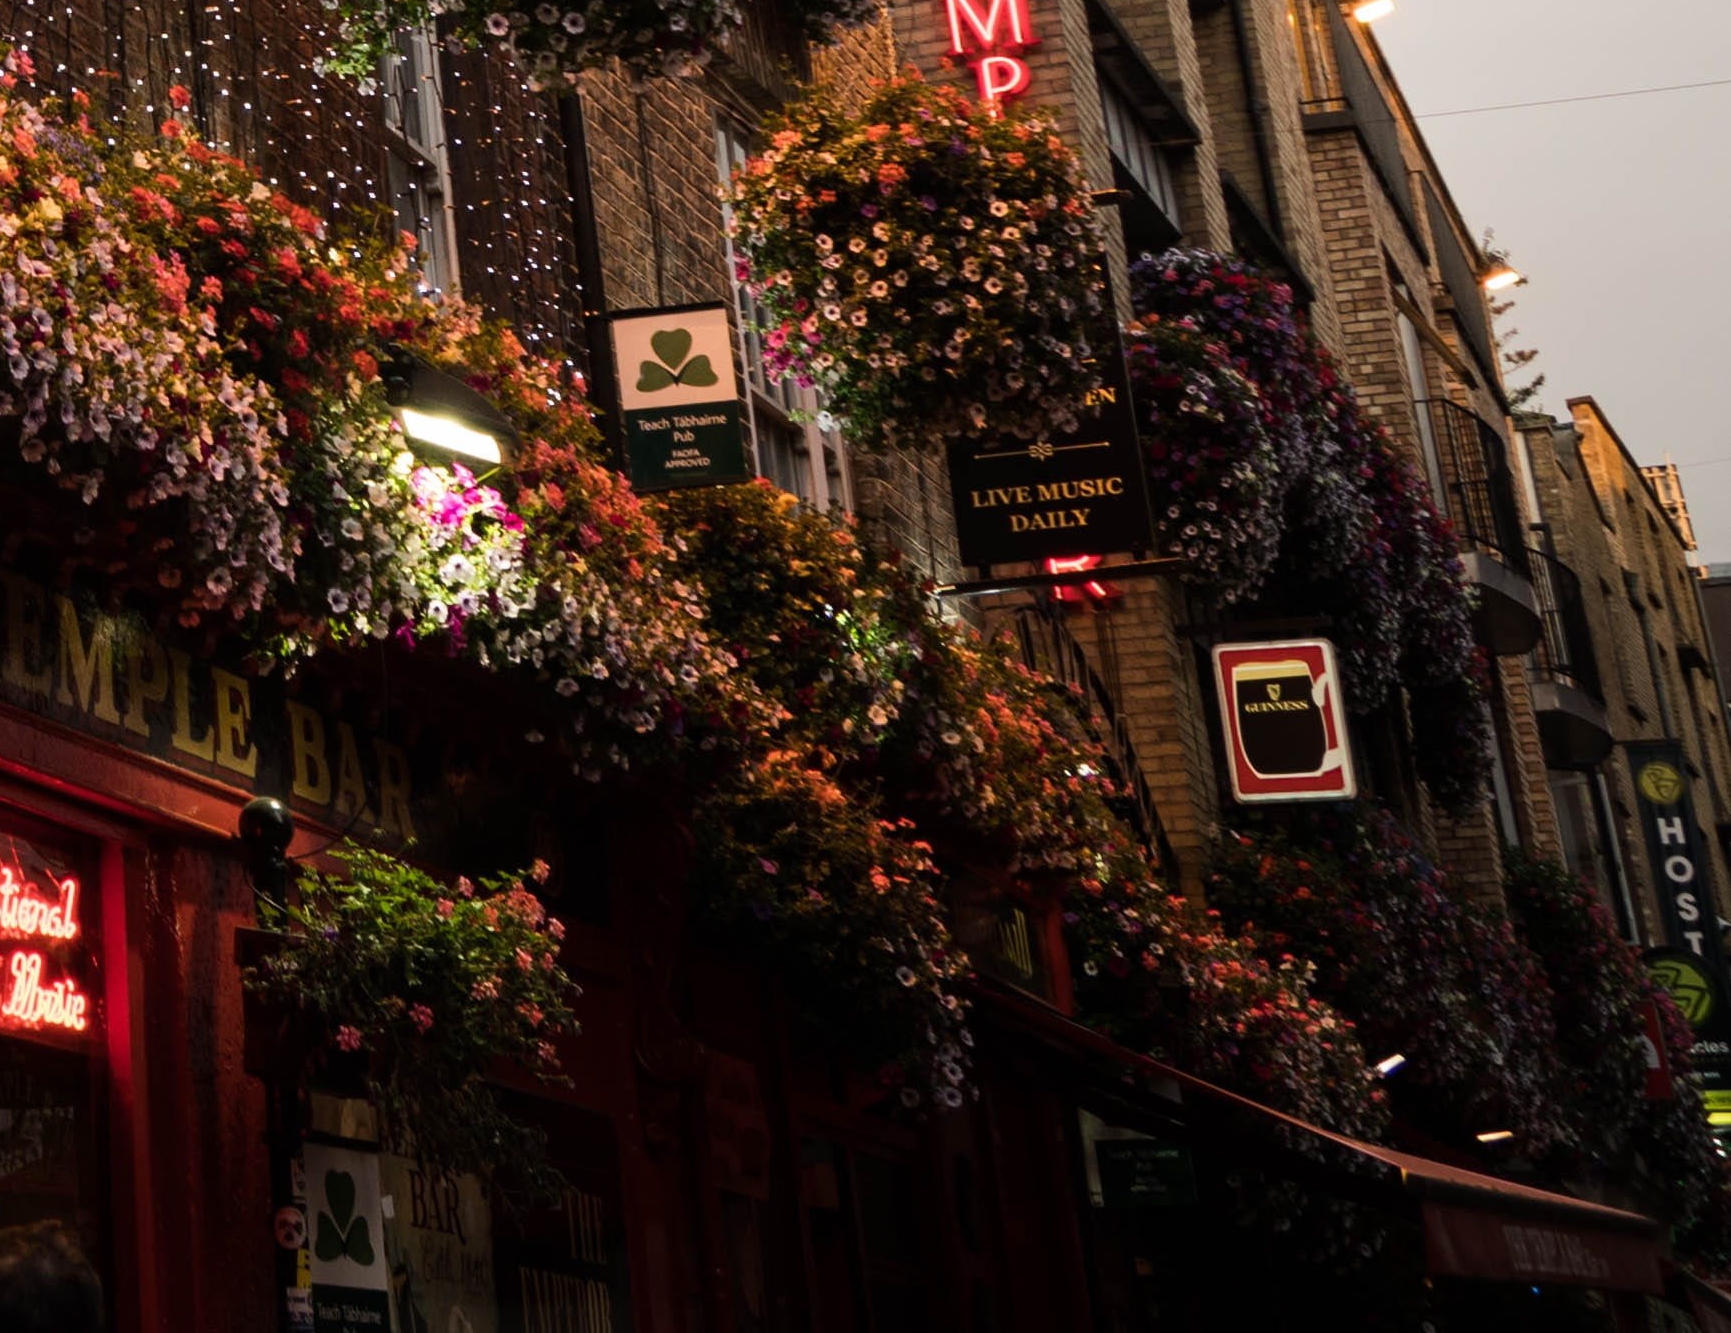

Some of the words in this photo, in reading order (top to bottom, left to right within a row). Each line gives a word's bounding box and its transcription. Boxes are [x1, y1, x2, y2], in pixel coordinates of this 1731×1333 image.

[636, 418, 671, 432] Teach
[673, 431, 696, 444] Pub
[664, 457, 711, 470] APPROVED
[970, 485, 1033, 509] LIVE
[1037, 477, 1126, 503] MUSIC
[1009, 507, 1091, 534] DAILY
[1244, 700, 1311, 714] GUINNESS
[287, 696, 420, 845] BAR
[1655, 816, 1706, 957] HOST
[1, 951, 86, 1030] Music
